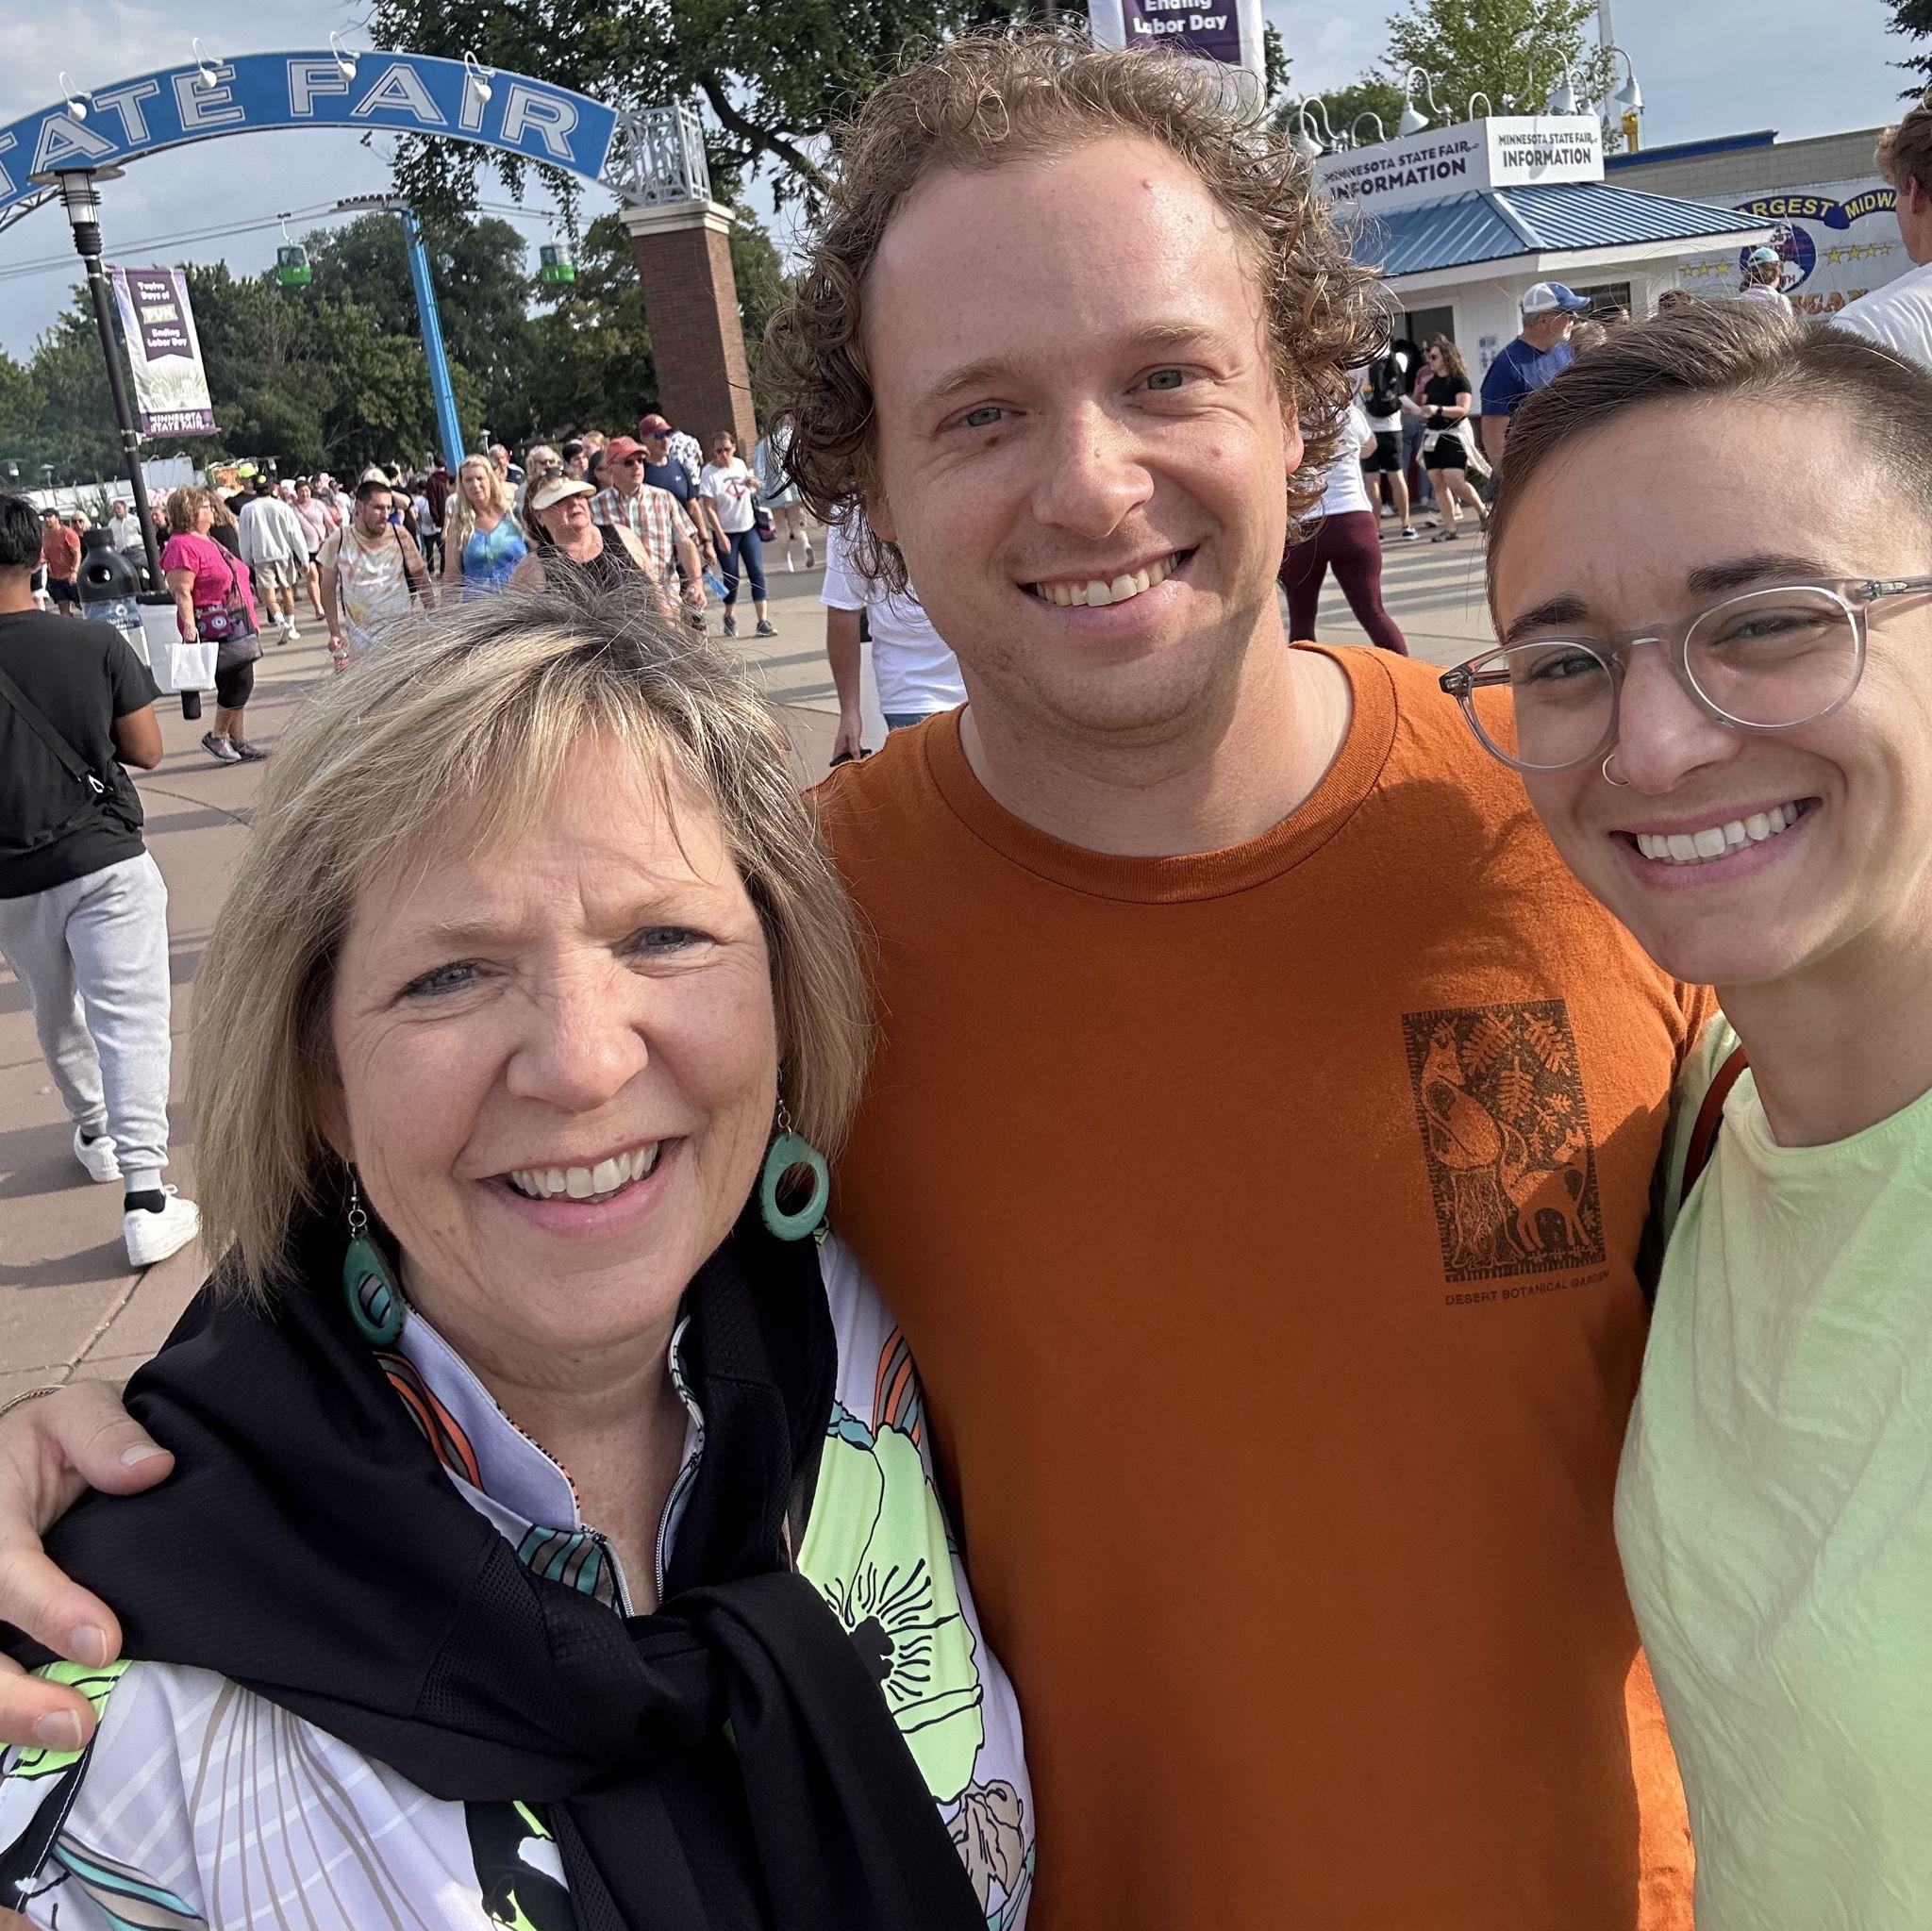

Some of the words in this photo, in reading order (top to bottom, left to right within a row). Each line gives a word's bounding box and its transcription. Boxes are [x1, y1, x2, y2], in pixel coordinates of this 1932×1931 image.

[1133, 17, 1187, 34] Labor
[1189, 14, 1228, 32] Day
[286, 58, 579, 163] FAIR
[1498, 133, 1547, 146] MINNESOTA
[1549, 132, 1574, 145] STATE
[1575, 132, 1594, 144] FAIR
[1399, 147, 1437, 167] STATE
[1439, 141, 1471, 157] FAIR
[1503, 147, 1591, 168] INFORMATION
[1330, 157, 1468, 200] INFORMATION
[1740, 198, 1835, 218] RGEST
[150, 411, 203, 424] MINNESOTA
[1445, 1290, 1498, 1306] DESERT
[1502, 1281, 1568, 1300] BOTANICAL
[1571, 1270, 1609, 1289] GARDEN
